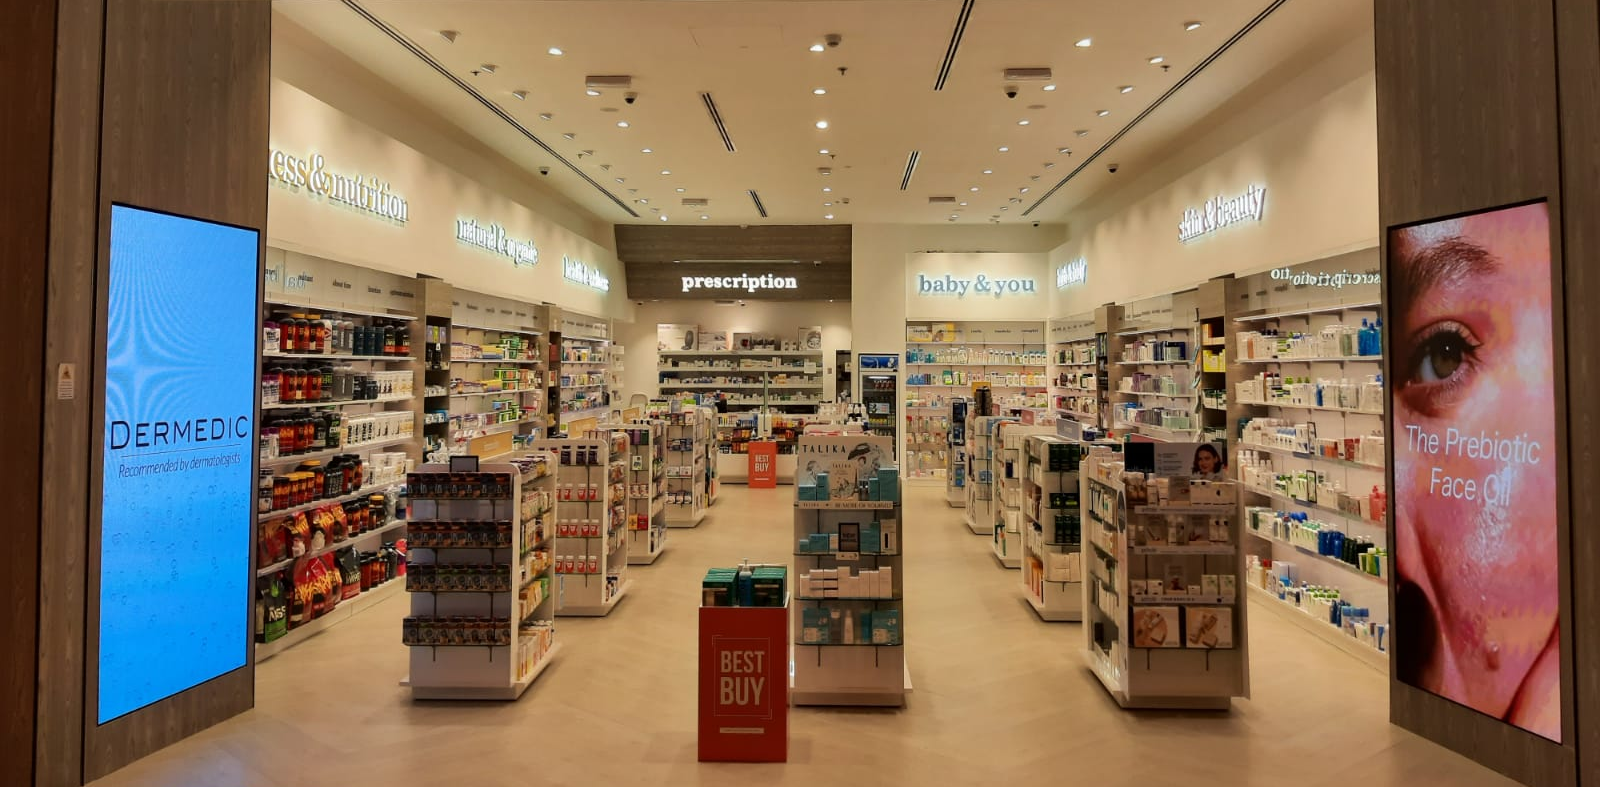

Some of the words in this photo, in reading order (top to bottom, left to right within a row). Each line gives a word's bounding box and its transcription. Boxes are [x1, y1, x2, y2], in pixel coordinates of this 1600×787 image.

[269, 149, 307, 189] ess
[308, 153, 330, 196] &
[328, 171, 410, 223] nutrition
[1178, 207, 1204, 242] skin
[1202, 199, 1217, 232] &
[1215, 184, 1267, 228] beauty
[456, 219, 498, 253] natural
[497, 227, 509, 256] &
[507, 237, 539, 267] organic
[681, 273, 798, 292] prescription
[919, 274, 970, 297] baby
[974, 274, 991, 293] &
[994, 278, 1035, 297] you
[110, 415, 249, 450] DERMEDIC
[1405, 424, 1439, 454] The
[1445, 428, 1541, 465] Prebiotic
[755, 454, 769, 462] BEST
[802, 444, 846, 453] TALIKA
[118, 460, 179, 478] Recommended
[179, 459, 189, 471] by
[190, 452, 241, 470] dermatologists
[754, 462, 769, 472] BUY
[1430, 467, 1476, 501] Face
[1483, 466, 1511, 506] Oil
[720, 651, 765, 673] BEST
[720, 677, 765, 705] BUY
